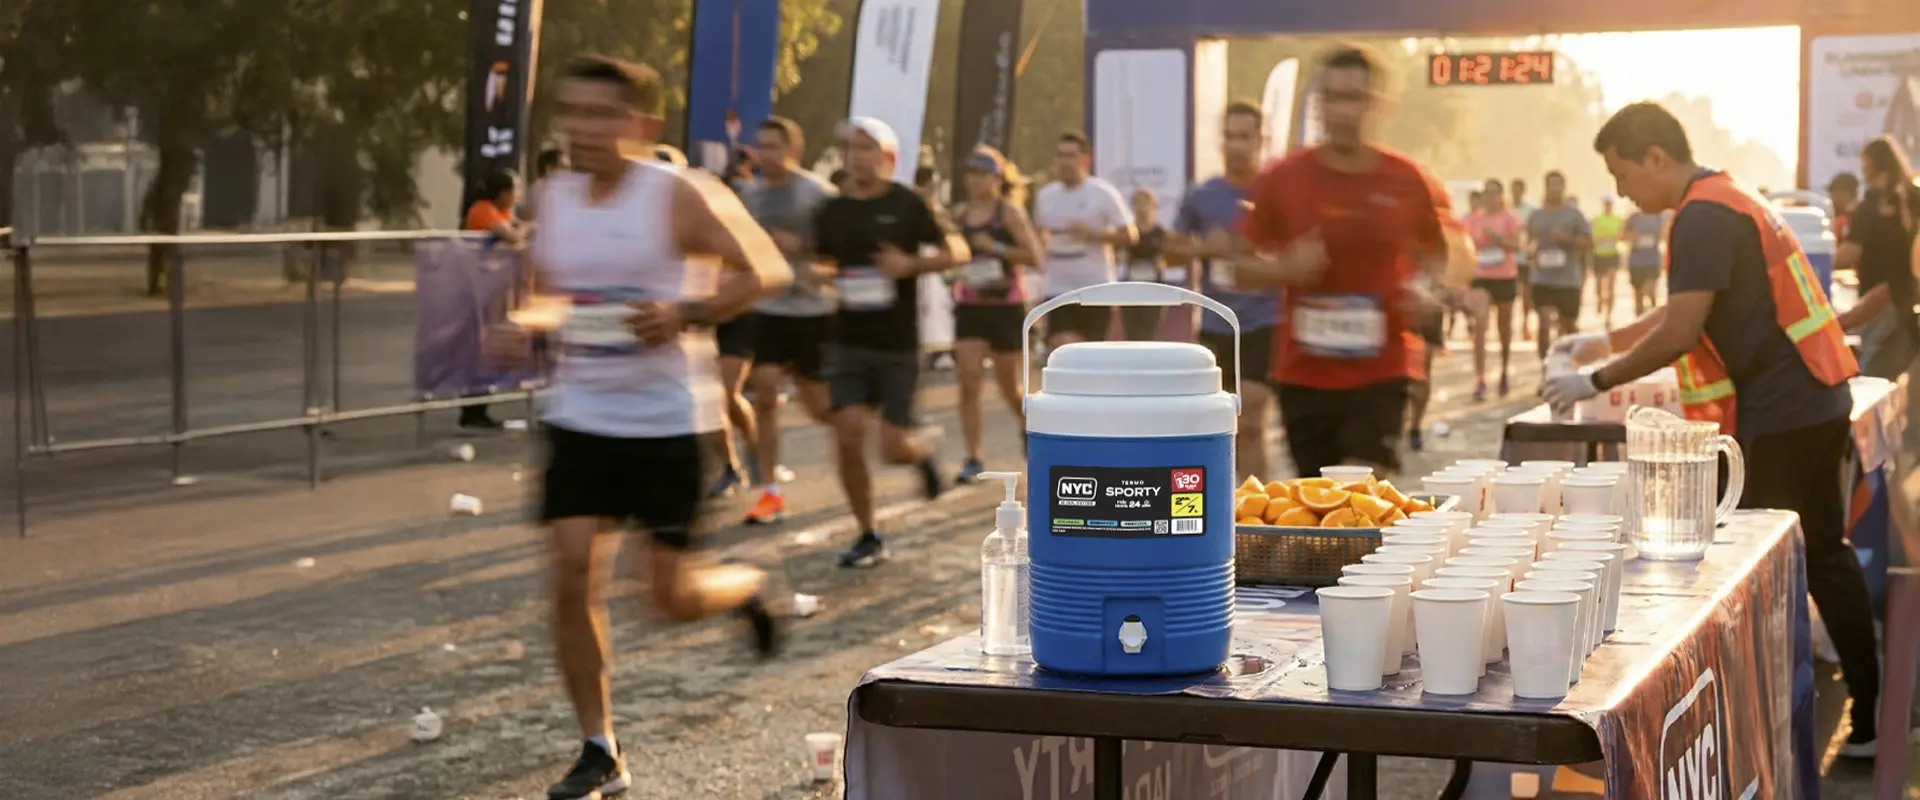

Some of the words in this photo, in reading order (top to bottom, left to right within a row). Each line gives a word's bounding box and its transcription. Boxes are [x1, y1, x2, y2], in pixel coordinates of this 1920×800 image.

[1182, 474, 1200, 485] 30
[1061, 482, 1093, 495] NYC
[1105, 486, 1161, 497] SPORTY
[1128, 500, 1141, 508] 24
